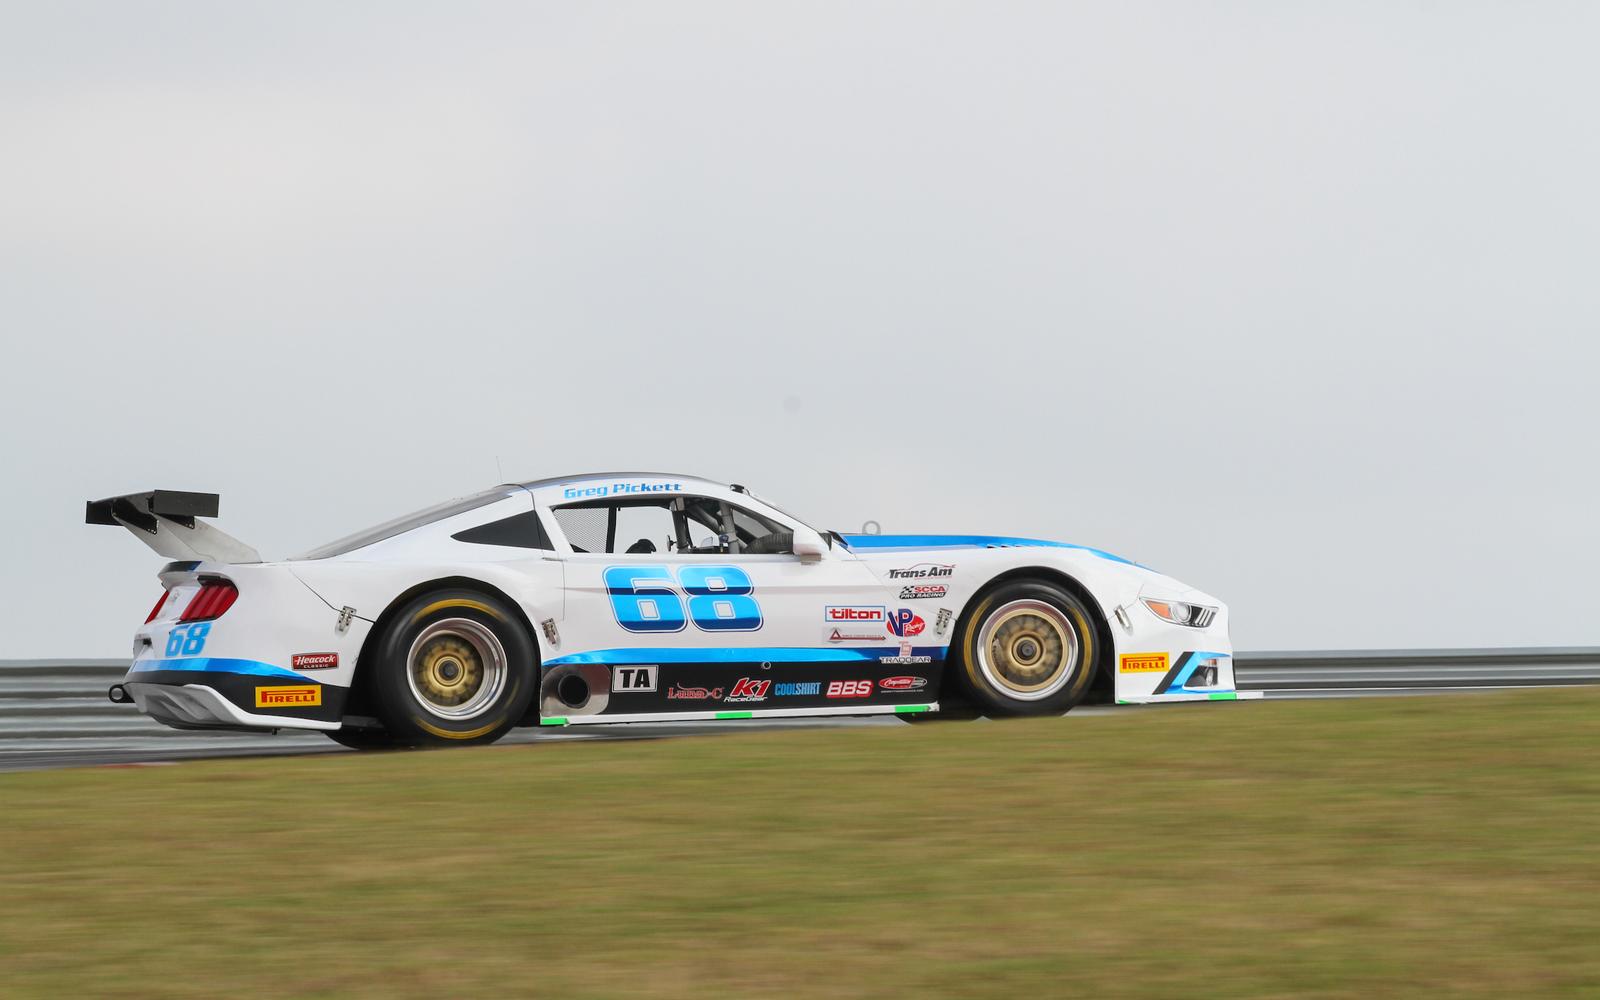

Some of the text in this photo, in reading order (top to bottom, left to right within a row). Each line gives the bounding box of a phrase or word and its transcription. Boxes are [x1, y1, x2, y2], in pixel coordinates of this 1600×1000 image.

[564, 483, 682, 499] Greg Pickett
[889, 567, 953, 579] Trans Am
[602, 564, 764, 633] 68
[829, 608, 881, 620] tilton
[887, 608, 914, 637] VP
[165, 622, 213, 657] 68
[294, 655, 336, 666] Heacock
[1122, 656, 1166, 670] PIRELLI
[620, 669, 651, 689] TA
[730, 677, 772, 698] K1
[774, 682, 822, 696] COOLSHIRT
[827, 680, 874, 697] BBS
[261, 689, 316, 703] PIRELLI
